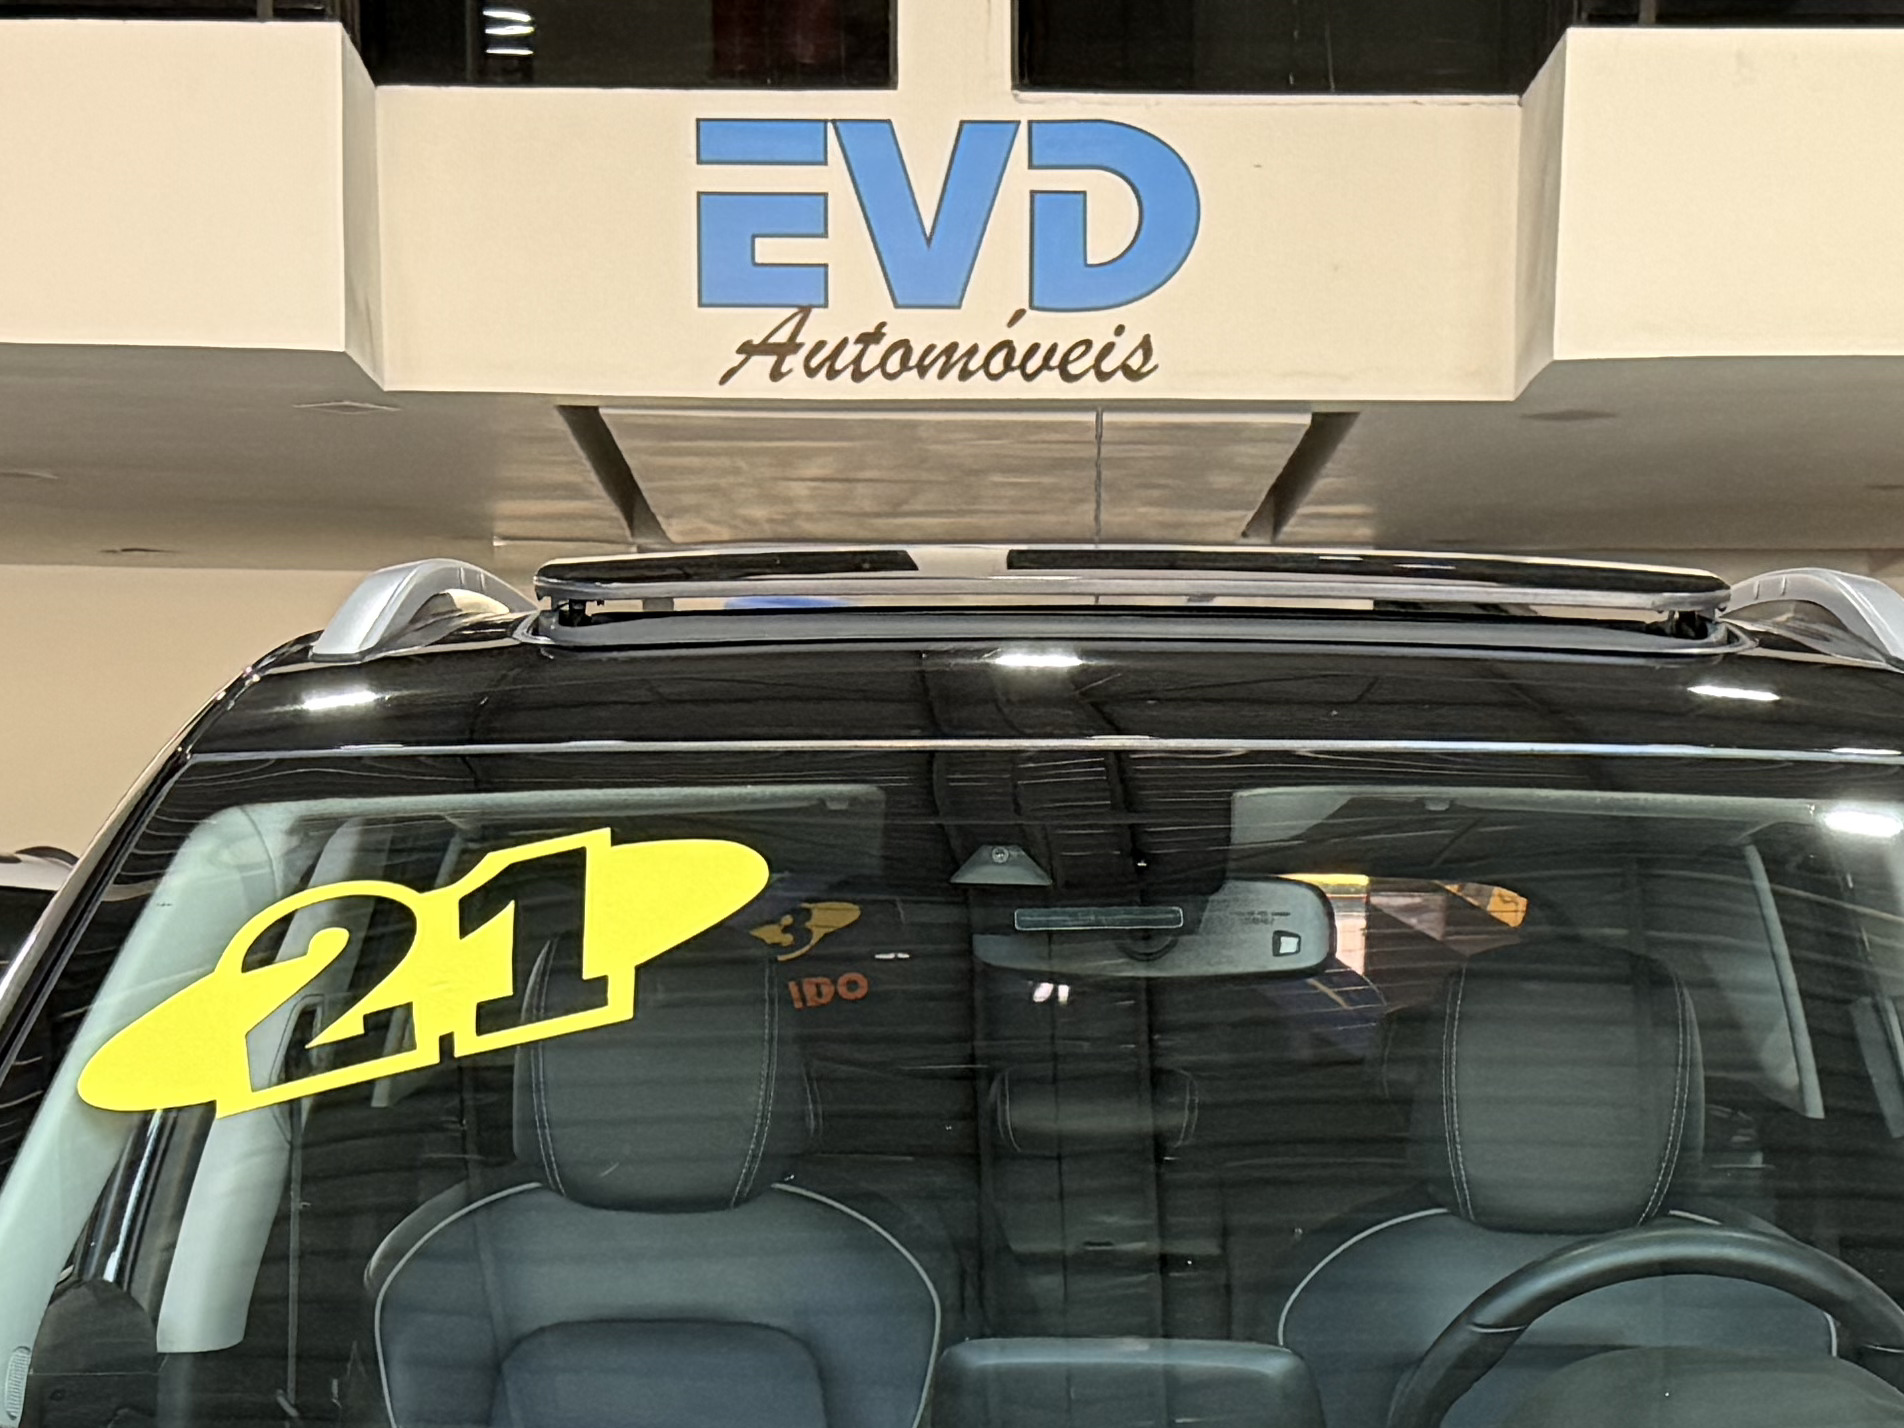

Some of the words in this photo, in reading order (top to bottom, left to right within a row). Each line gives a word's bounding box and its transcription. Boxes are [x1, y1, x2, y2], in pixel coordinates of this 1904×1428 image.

[696, 118, 1201, 312] EVD
[718, 305, 1160, 385] Automóveis
[236, 840, 618, 1098] 21
